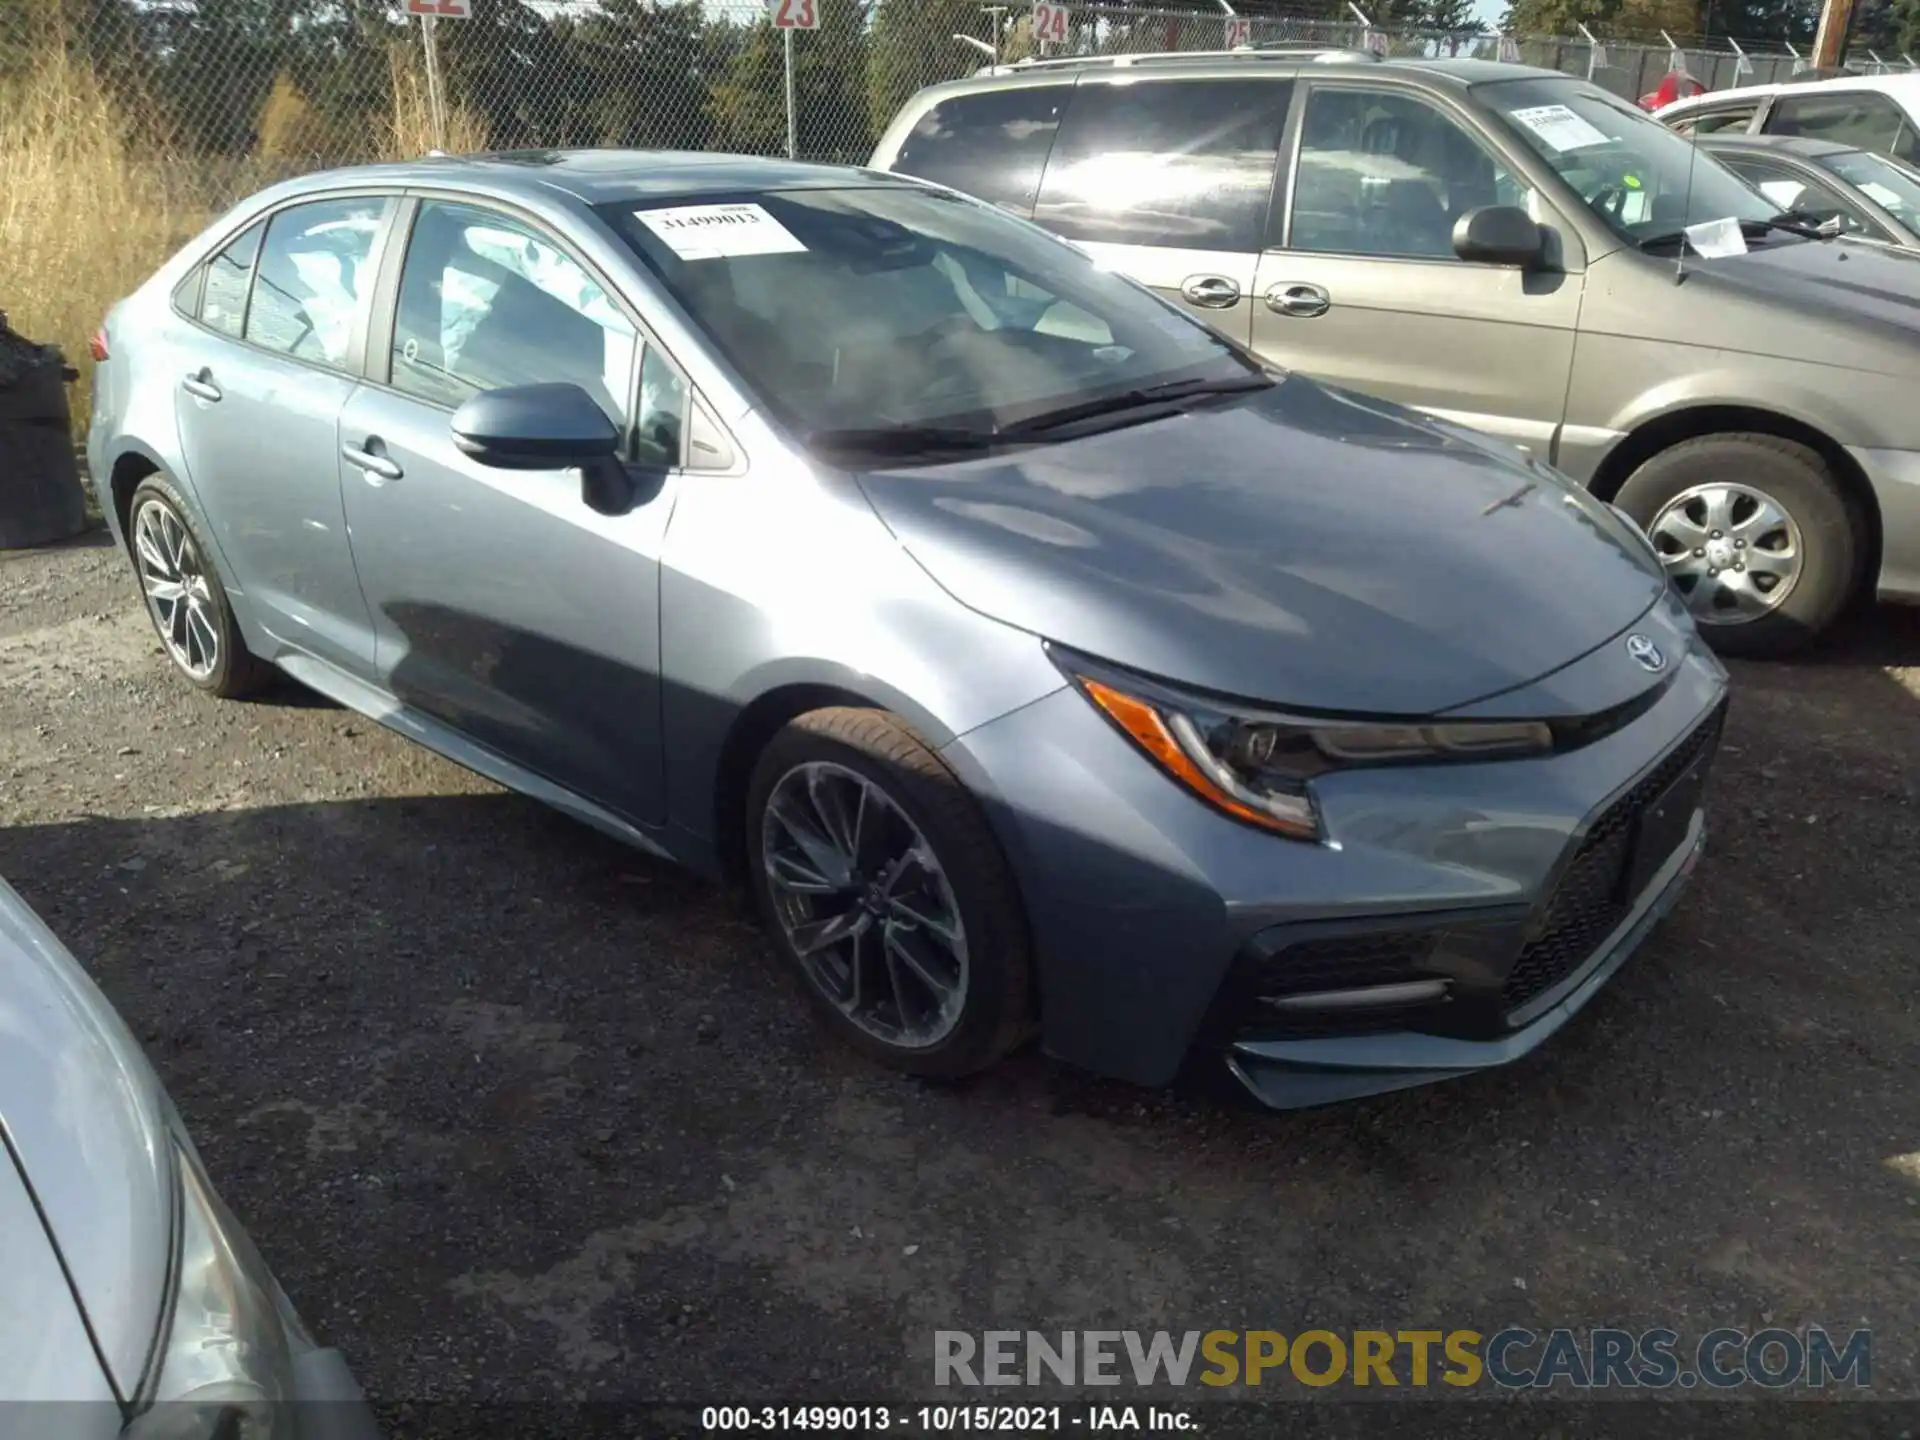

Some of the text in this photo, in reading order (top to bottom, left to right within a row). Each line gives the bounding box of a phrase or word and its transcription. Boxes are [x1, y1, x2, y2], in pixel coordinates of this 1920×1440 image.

[775, 0, 815, 27] 23
[1036, 4, 1066, 40] 24
[661, 213, 760, 230] 31499013
